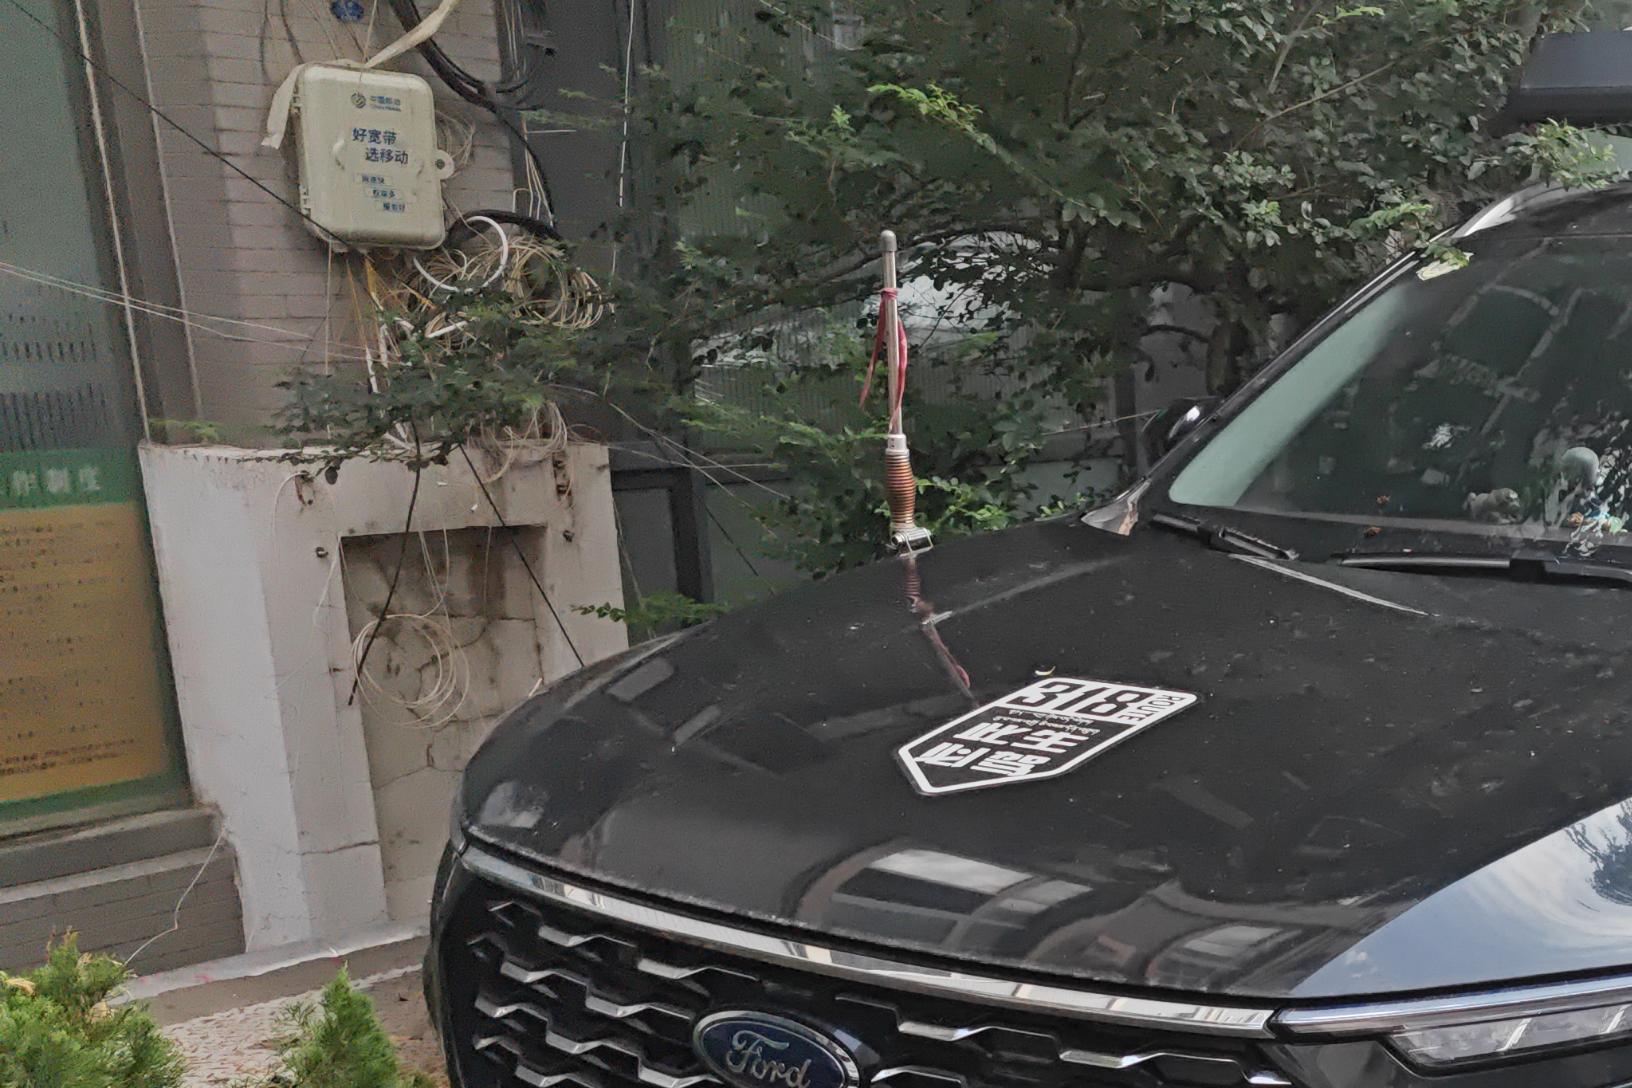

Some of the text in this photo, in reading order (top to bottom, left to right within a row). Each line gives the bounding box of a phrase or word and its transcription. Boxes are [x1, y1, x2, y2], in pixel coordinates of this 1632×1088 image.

[353, 128, 397, 145] 好宽带
[365, 148, 409, 165] 选移动
[1006, 681, 1153, 717] 318
[1118, 693, 1182, 723] ROUTE
[953, 722, 1089, 754] 此生
[915, 742, 1052, 777] 必驾
